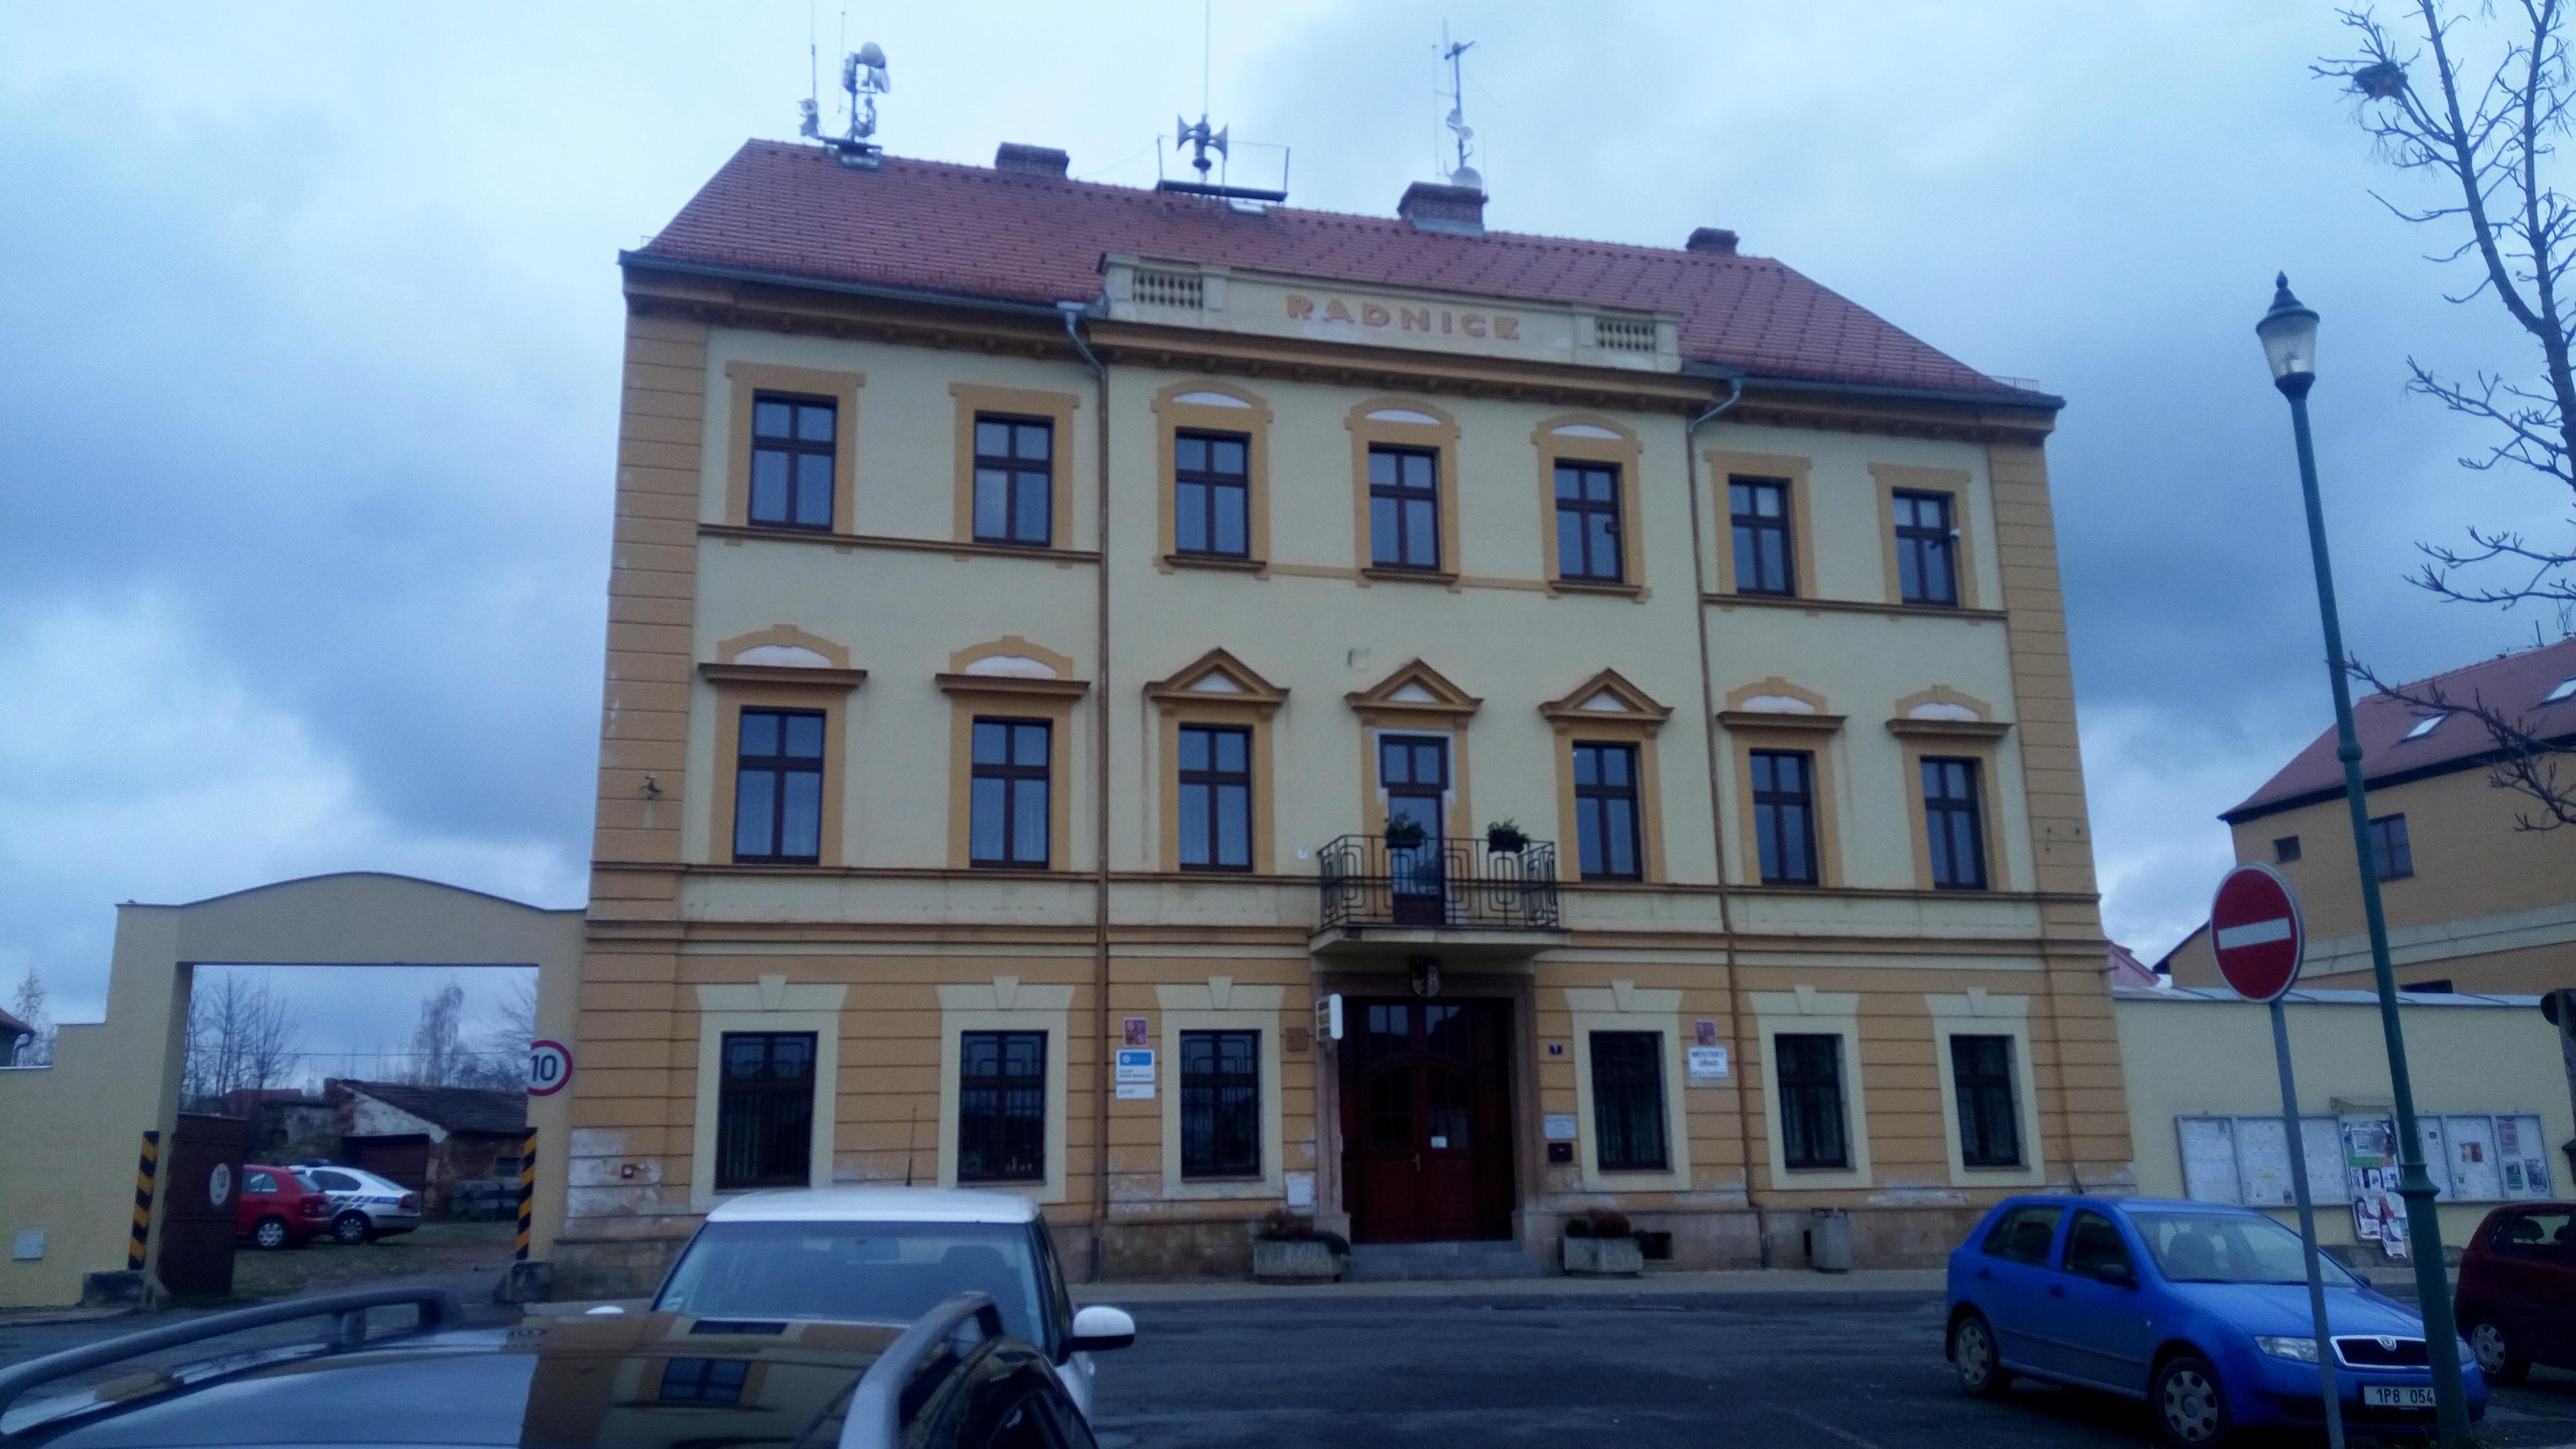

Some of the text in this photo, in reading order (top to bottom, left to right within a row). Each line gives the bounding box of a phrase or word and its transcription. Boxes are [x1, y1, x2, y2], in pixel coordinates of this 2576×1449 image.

[1287, 295, 1520, 340] RADNICE
[530, 1055, 557, 1081] 10
[2376, 1388, 2433, 1404] 1P8 054
